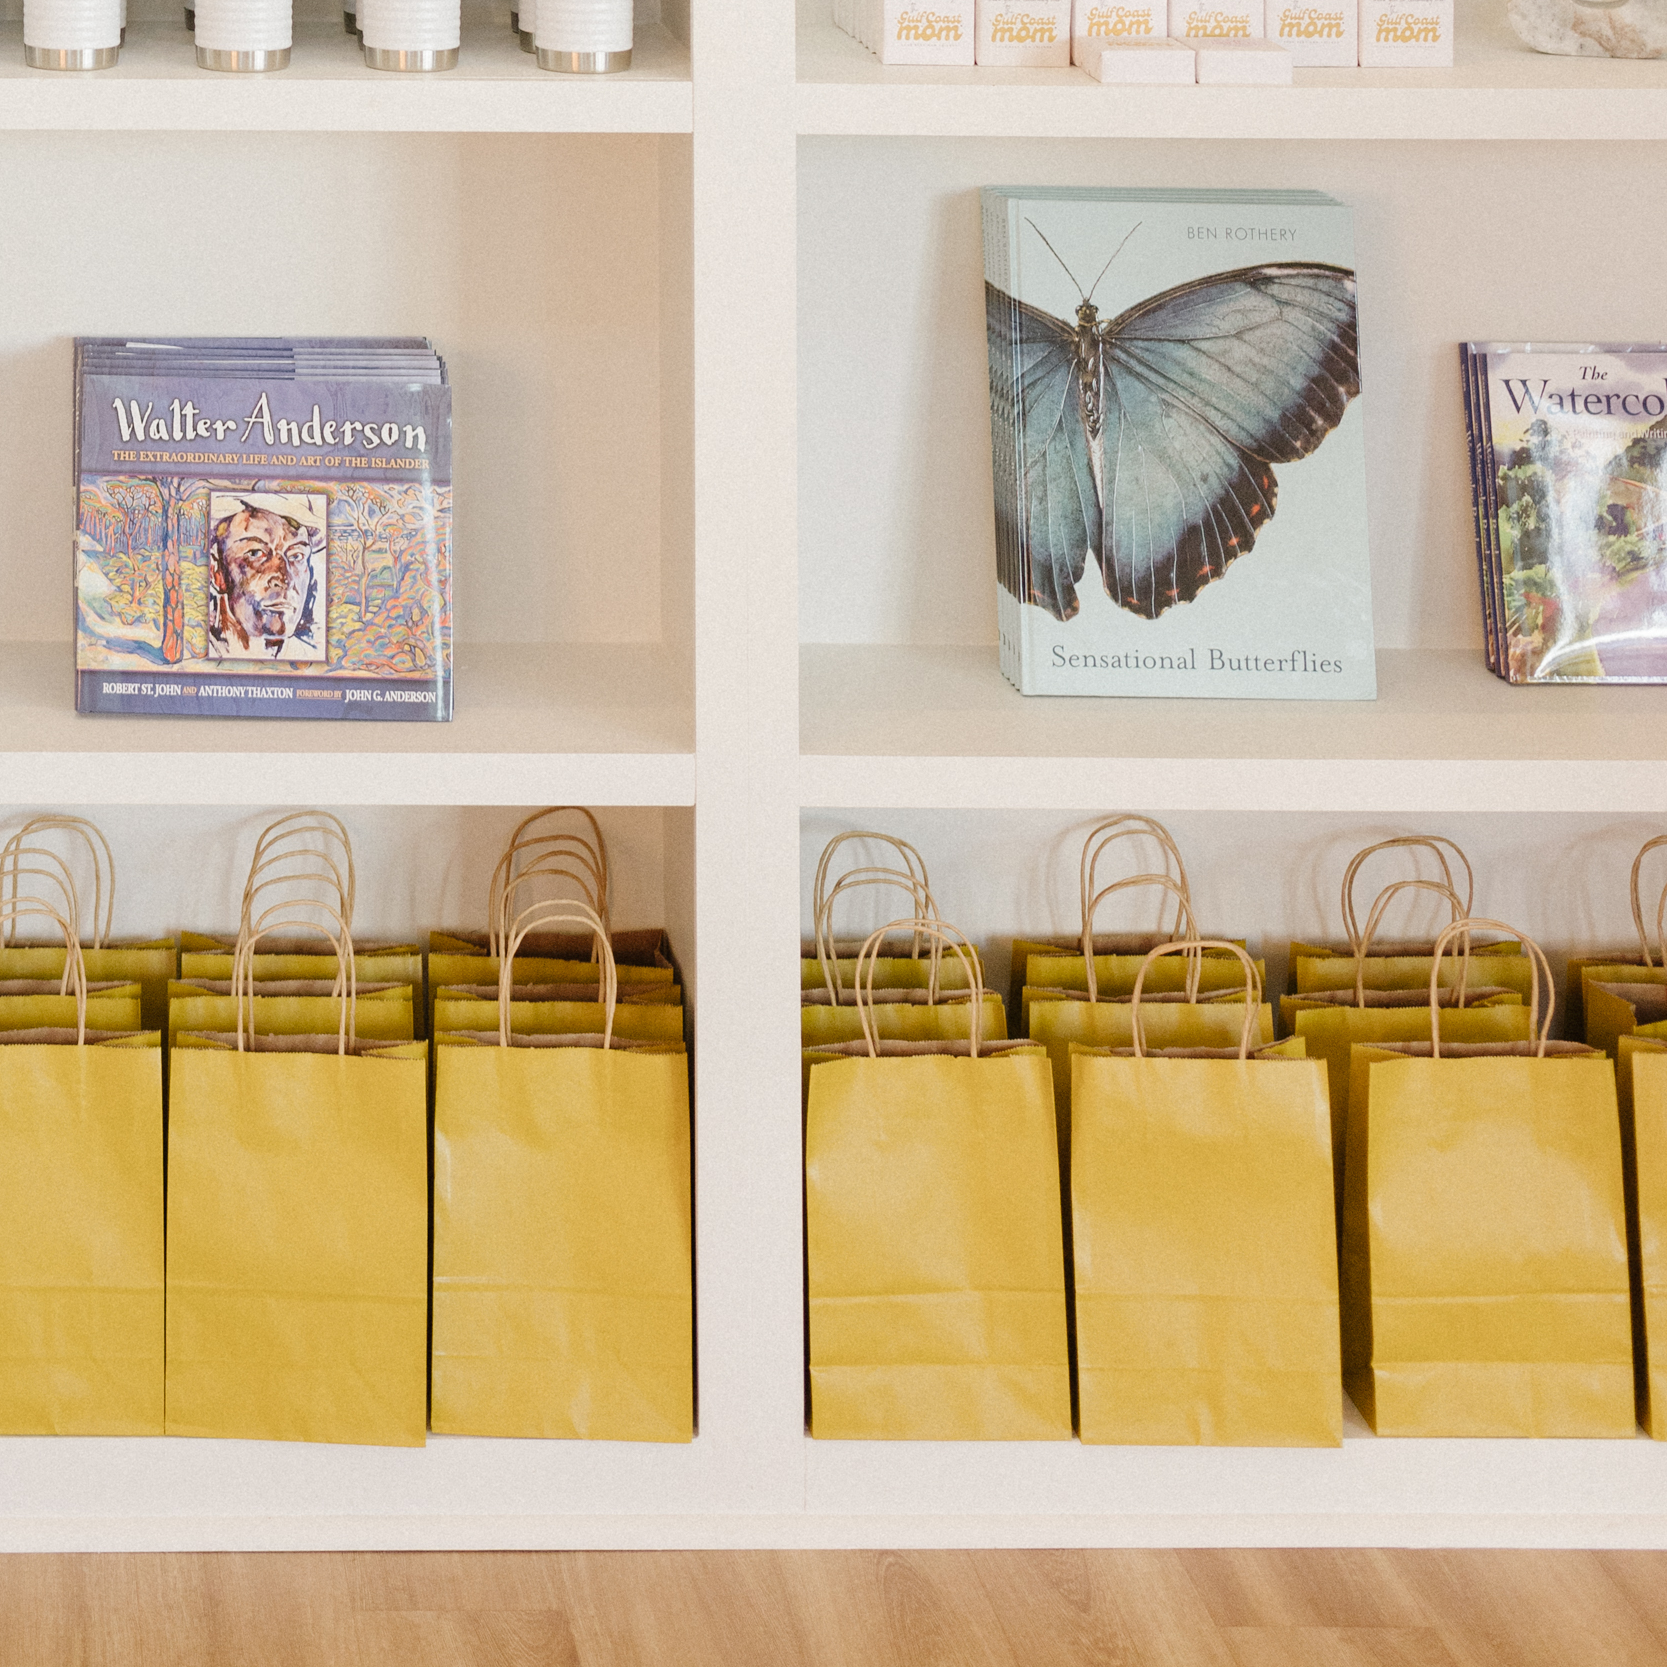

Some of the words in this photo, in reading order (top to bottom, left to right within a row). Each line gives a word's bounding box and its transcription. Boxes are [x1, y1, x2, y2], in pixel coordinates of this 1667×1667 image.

[896, 23, 963, 42] mom
[1188, 227, 1219, 240] BEN
[1225, 227, 1297, 242] ROTHERY
[1579, 366, 1608, 381] The
[112, 398, 236, 443] Walter
[241, 392, 427, 452] Anderson
[112, 450, 137, 461] THE
[139, 451, 240, 464] EXTRAORDINARY
[242, 453, 268, 464] LIFE
[271, 454, 296, 466] AND
[299, 455, 322, 466] ART
[325, 456, 343, 467] OF
[344, 457, 369, 467] THE
[371, 457, 429, 469] ISLANDER
[1051, 645, 1197, 670] Sensational
[1209, 649, 1344, 675] Butterflies
[103, 682, 139, 695] ROBERT
[141, 683, 153, 695] ST.
[154, 683, 182, 698] JOHN
[183, 686, 197, 695] AND
[198, 685, 247, 698] ANTHONY
[247, 686, 293, 699] THAXTON
[296, 689, 331, 698] FOREWORD
[344, 689, 373, 702] JOHN
[373, 690, 384, 701] G.
[384, 690, 436, 703] ANDERSON
